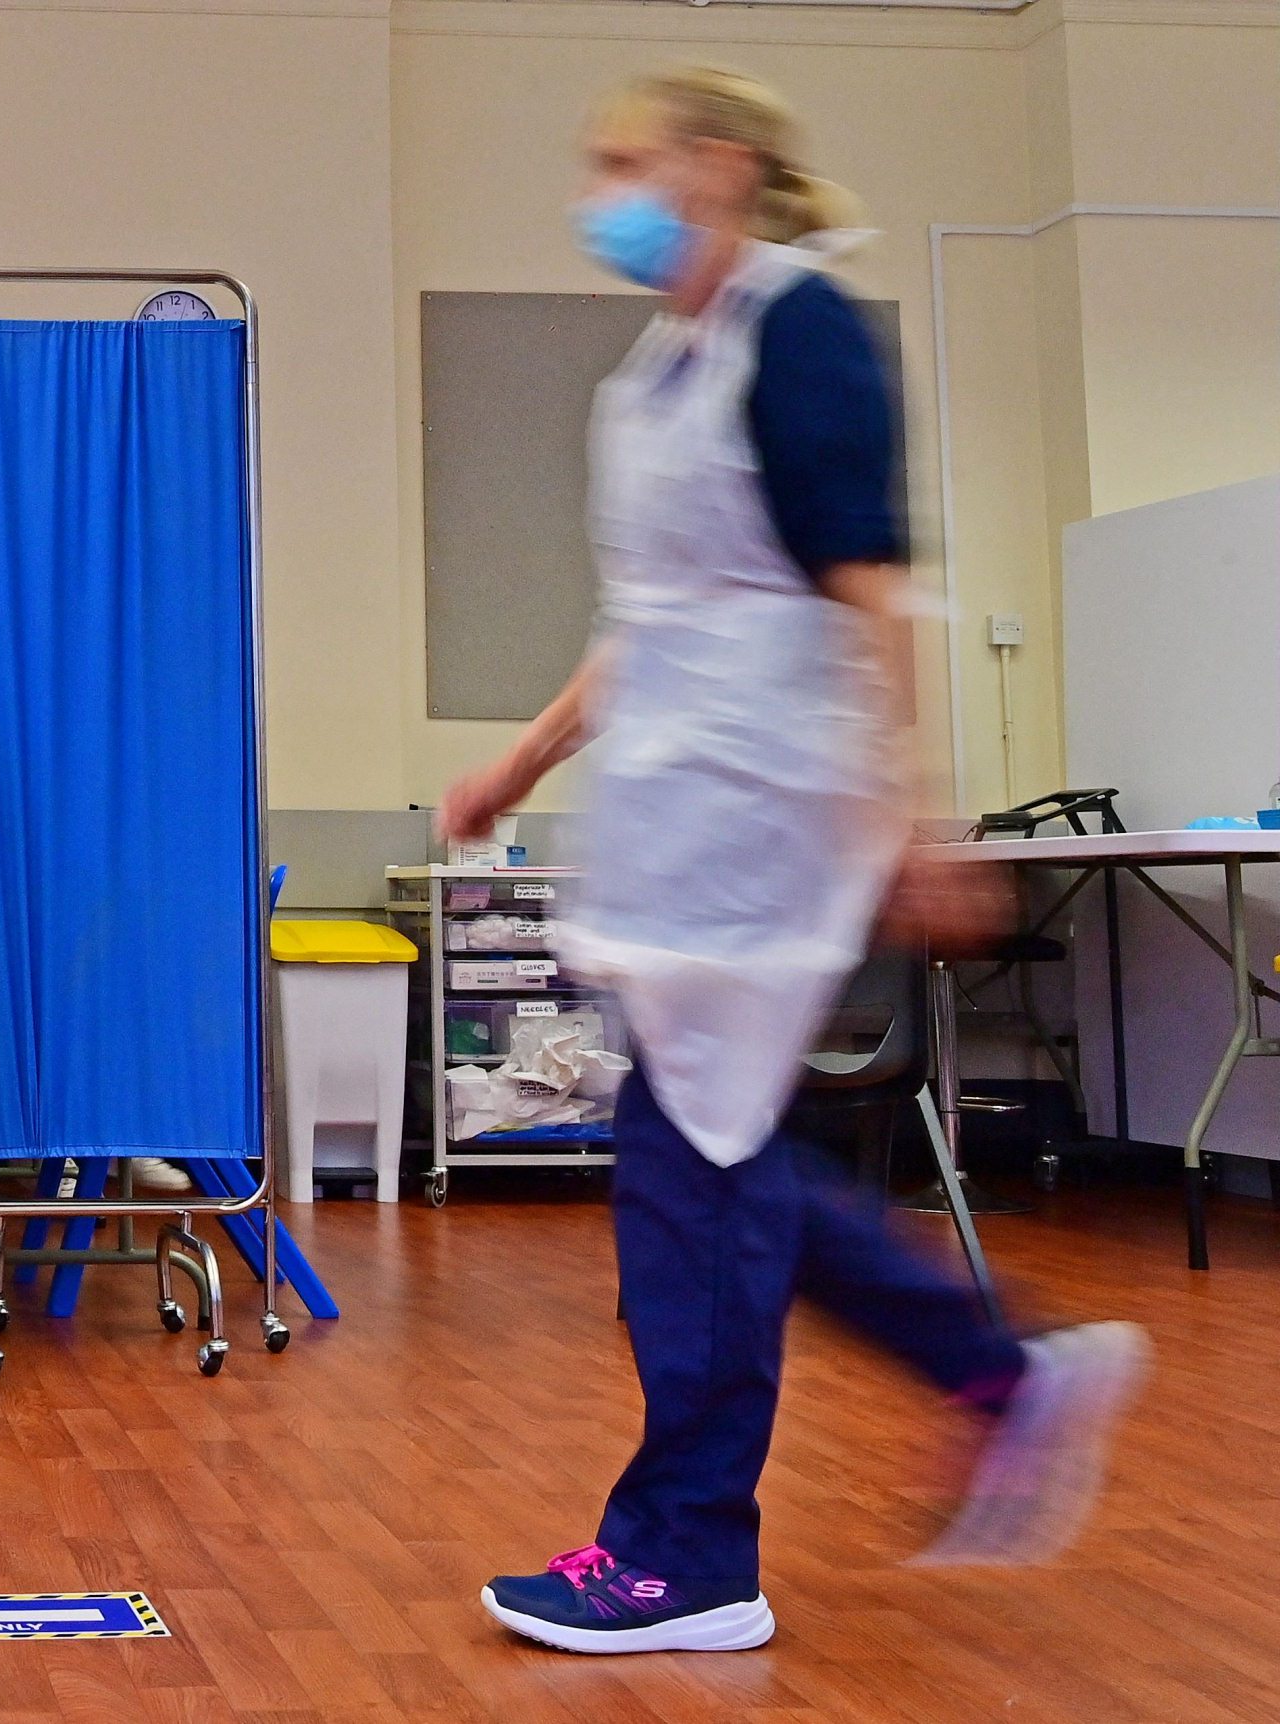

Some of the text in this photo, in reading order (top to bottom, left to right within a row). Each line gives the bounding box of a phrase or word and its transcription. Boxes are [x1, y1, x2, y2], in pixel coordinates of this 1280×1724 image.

[170, 295, 181, 306] 12
[156, 301, 163, 311] 11
[202, 311, 209, 320] 2
